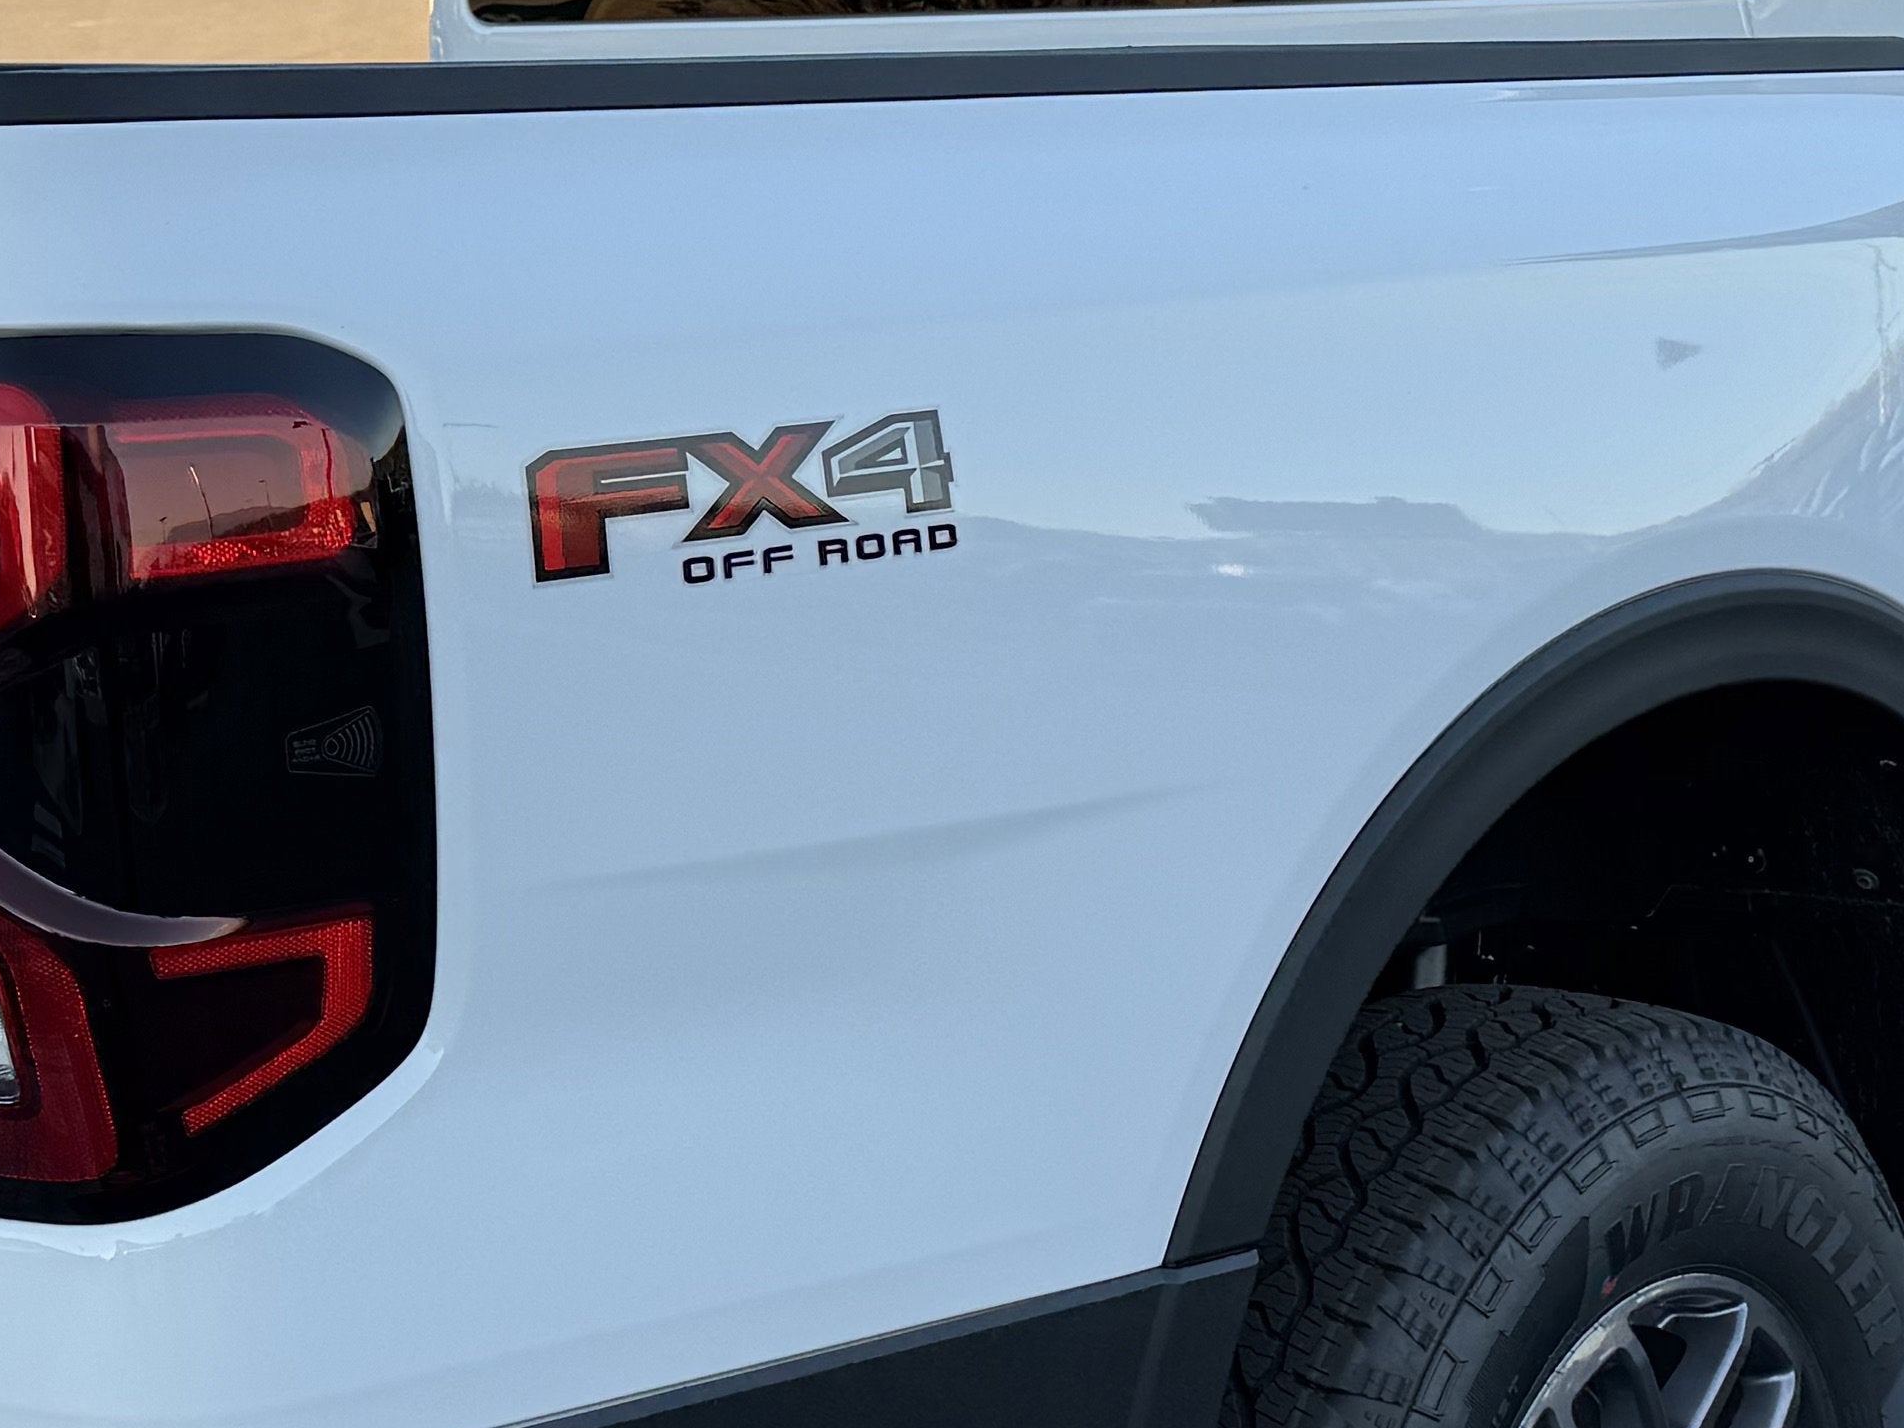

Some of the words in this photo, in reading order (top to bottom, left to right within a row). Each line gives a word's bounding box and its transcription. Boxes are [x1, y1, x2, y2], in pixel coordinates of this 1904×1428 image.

[524, 408, 955, 583] FX4
[682, 544, 795, 585] OFF
[817, 523, 958, 568] ROAD
[1603, 1163, 1903, 1359] WRANGLER
